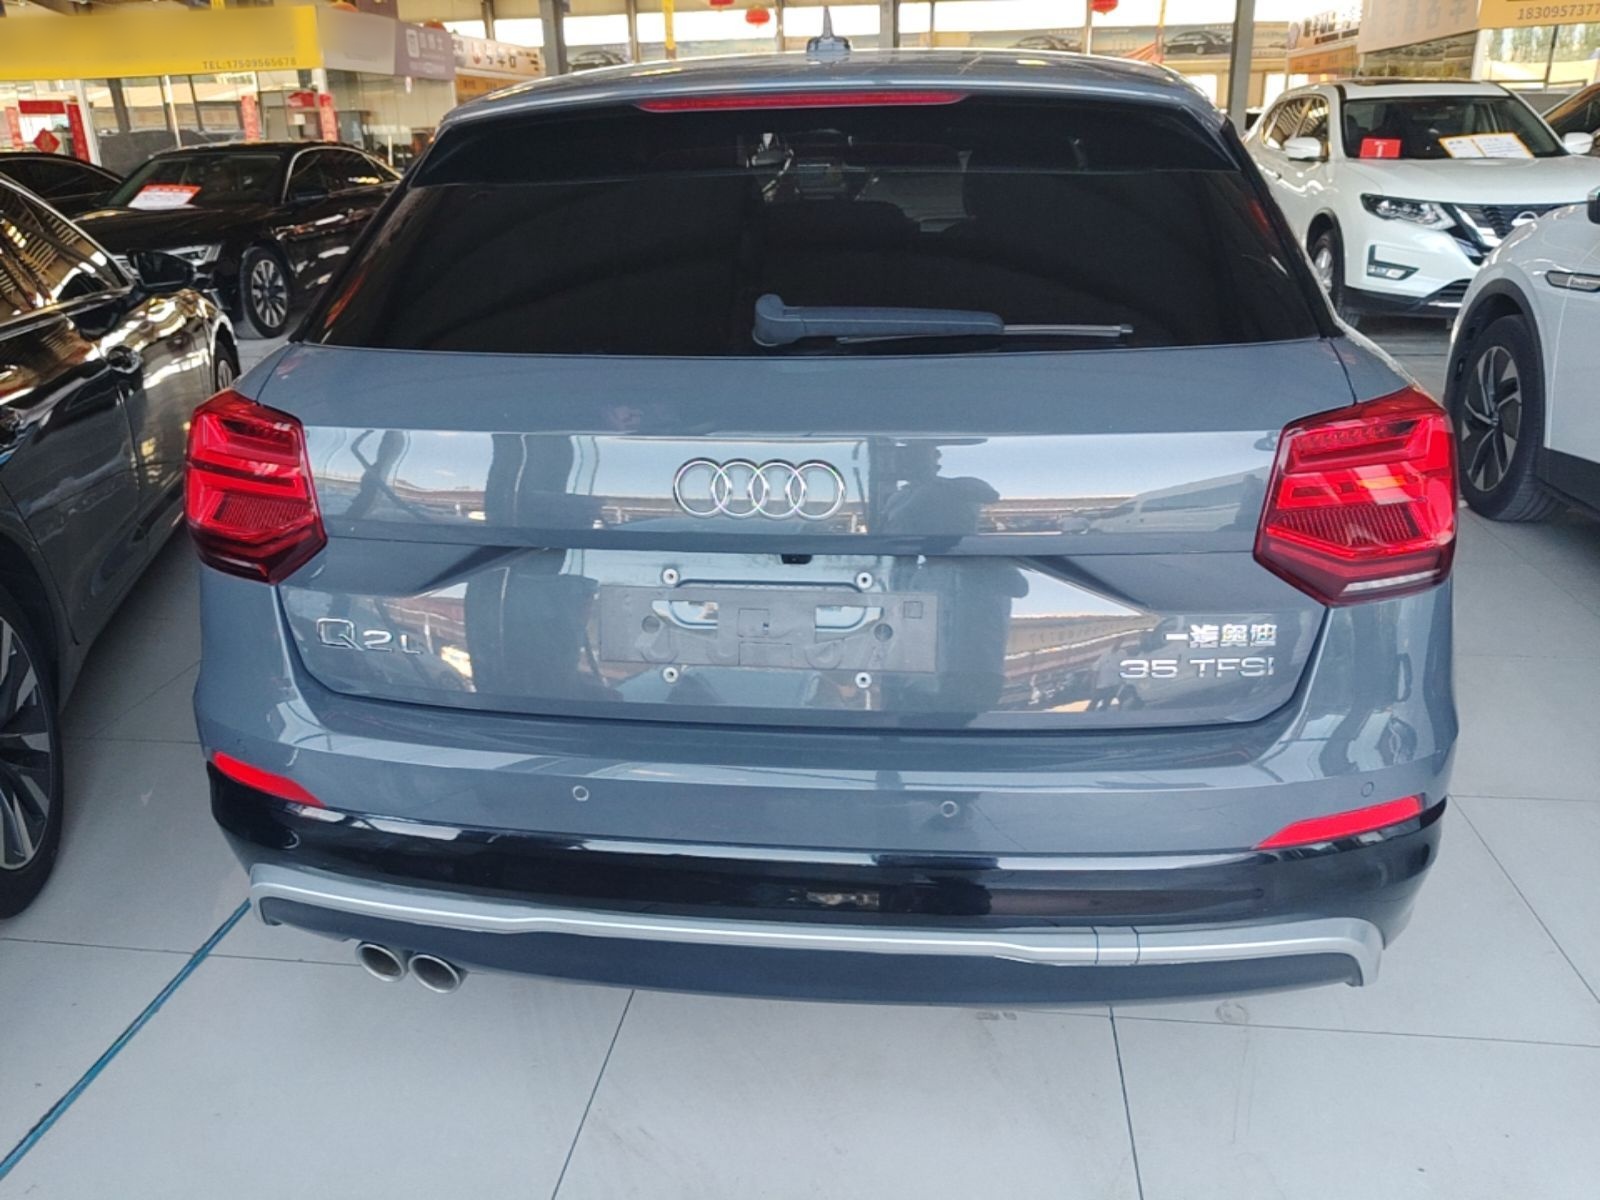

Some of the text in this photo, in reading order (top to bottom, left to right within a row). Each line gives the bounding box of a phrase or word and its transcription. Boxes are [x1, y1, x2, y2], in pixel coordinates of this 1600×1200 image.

[317, 617, 421, 654] Q2L
[1119, 657, 1275, 679] 35 TFSI
